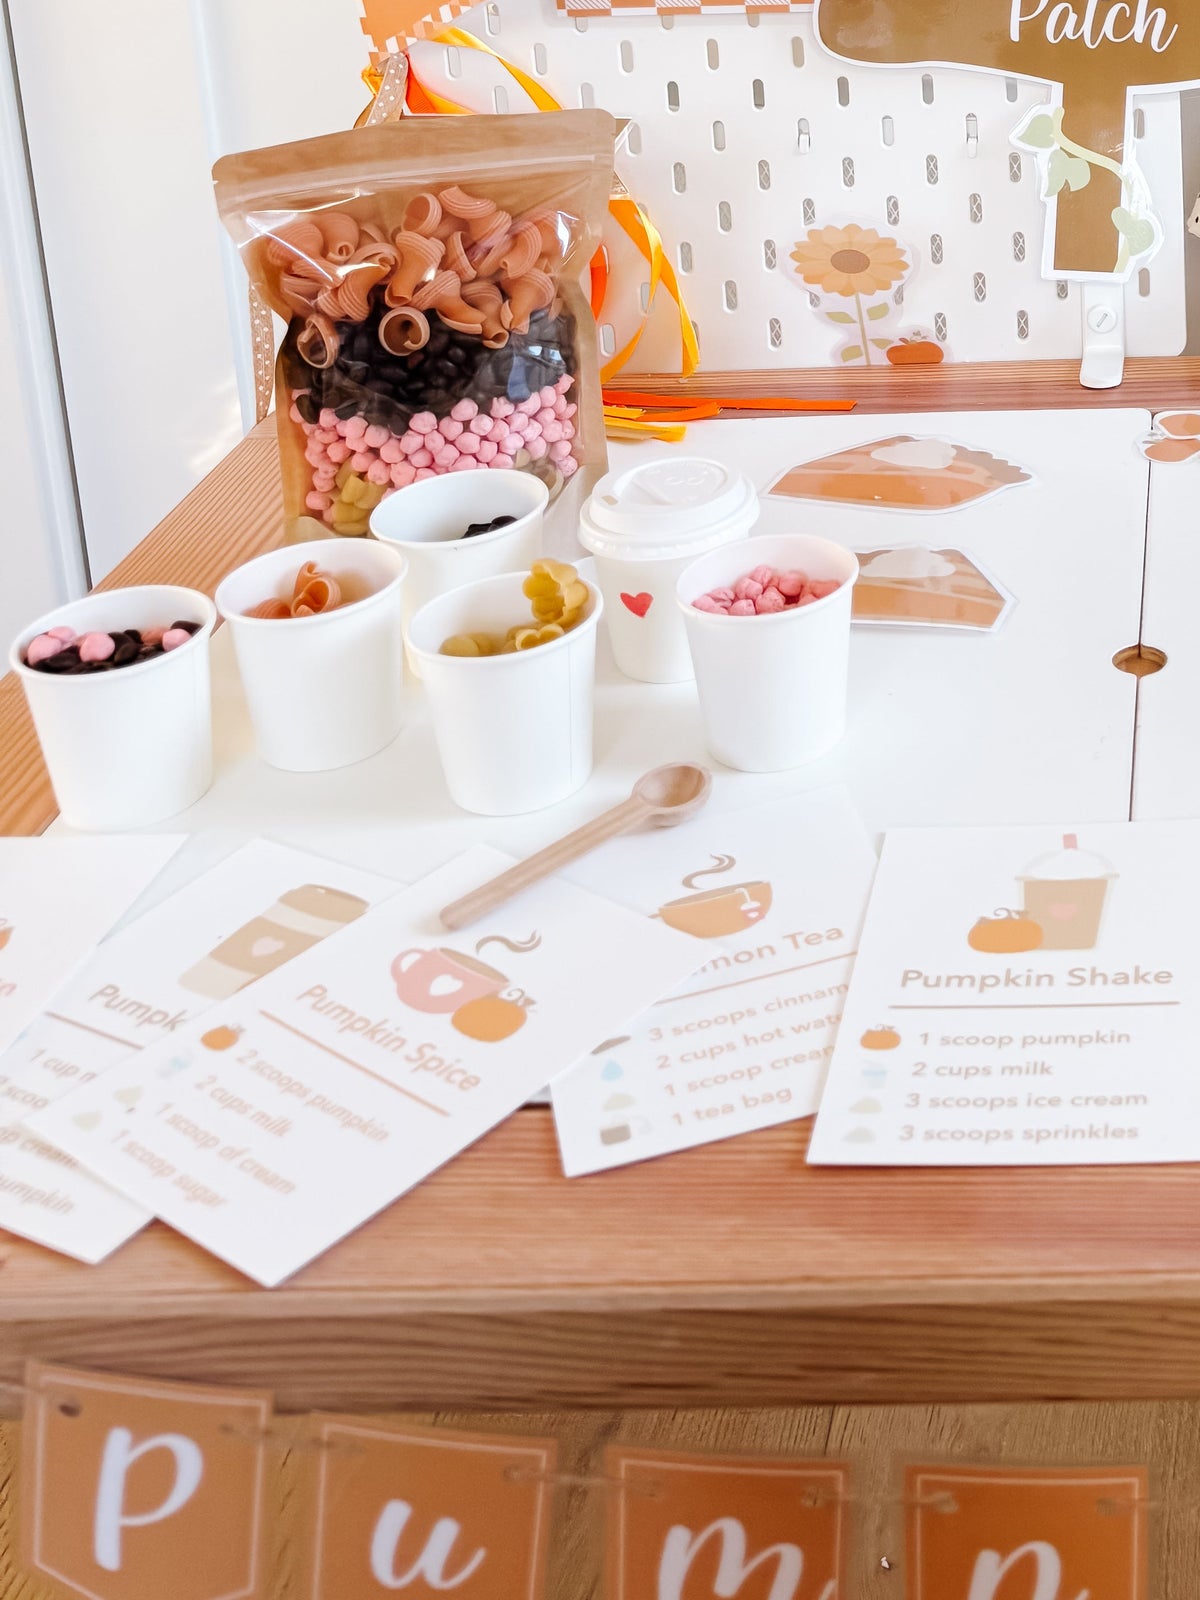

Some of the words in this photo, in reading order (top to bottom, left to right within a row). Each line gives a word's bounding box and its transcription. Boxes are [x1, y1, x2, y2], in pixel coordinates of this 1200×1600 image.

[783, 927, 844, 951] Tea
[901, 967, 1055, 993] Pumpkin
[1067, 965, 1174, 987] Shake
[295, 983, 408, 1054] Pumpkin
[404, 1042, 482, 1093] Spice
[649, 1027, 664, 1042] 3
[672, 1006, 758, 1038] scoops
[919, 1032, 930, 1046] 1
[939, 1033, 1015, 1050] scoop
[1020, 1030, 1132, 1050] pumpkin
[657, 1054, 671, 1070] 2
[679, 1041, 737, 1066] cups
[743, 1026, 785, 1047] hot
[43, 1057, 81, 1079] cup
[663, 1083, 676, 1096] 1
[687, 1065, 763, 1093] scoop
[911, 1061, 927, 1077] 2
[935, 1063, 993, 1081] cups
[999, 1060, 1053, 1076] milk
[195, 1075, 219, 1092] 2
[210, 1084, 253, 1117] cups
[250, 1107, 296, 1139] milk
[236, 1049, 259, 1065] 2
[252, 1060, 313, 1100] scoops
[305, 1094, 391, 1144] pumpkin
[672, 1113, 683, 1126] 1
[694, 1102, 736, 1121] tea
[742, 1087, 794, 1110] bag
[905, 1093, 921, 1108] 3
[928, 1094, 1019, 1112] scoops
[1026, 1093, 1063, 1107] ice
[1069, 1092, 1150, 1106] cream
[153, 1102, 176, 1117] 1
[166, 1111, 221, 1150] scoop
[240, 1156, 297, 1196] cream
[899, 1125, 915, 1141] 3
[923, 1127, 1015, 1145] scoops
[1021, 1123, 1141, 1144] sprinkles
[110, 1129, 132, 1146] 1
[122, 1139, 178, 1180] scoop
[171, 1174, 226, 1208] sugar
